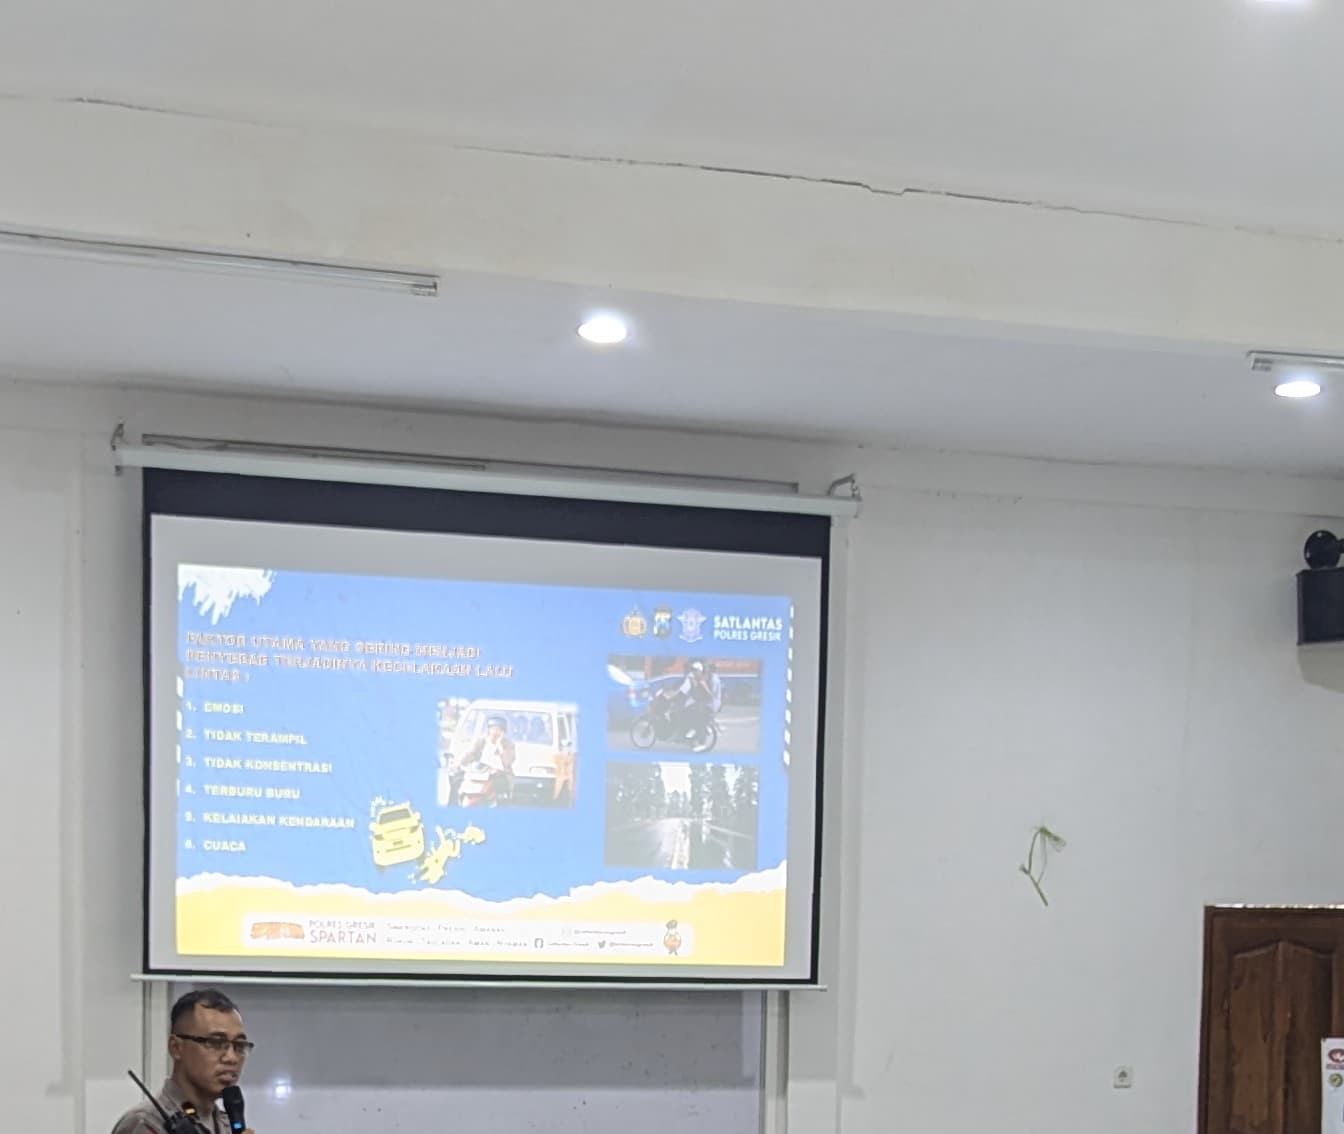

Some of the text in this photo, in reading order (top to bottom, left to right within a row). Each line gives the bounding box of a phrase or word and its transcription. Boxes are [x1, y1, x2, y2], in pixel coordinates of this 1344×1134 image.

[714, 615, 783, 631] SATLANTAS
[714, 629, 782, 641] POLRES GRESIK
[204, 702, 244, 714] EMOSI
[185, 729, 308, 745] 2. TIDAK TERAMPIL
[204, 757, 242, 769] TIDAK
[246, 759, 332, 773] KONSENTRASI
[204, 784, 262, 798] TERBURU
[266, 788, 301, 799] BURU
[279, 816, 354, 829] KENDARAAN
[203, 840, 247, 851] CUACA
[309, 929, 377, 944] SPARTAN
